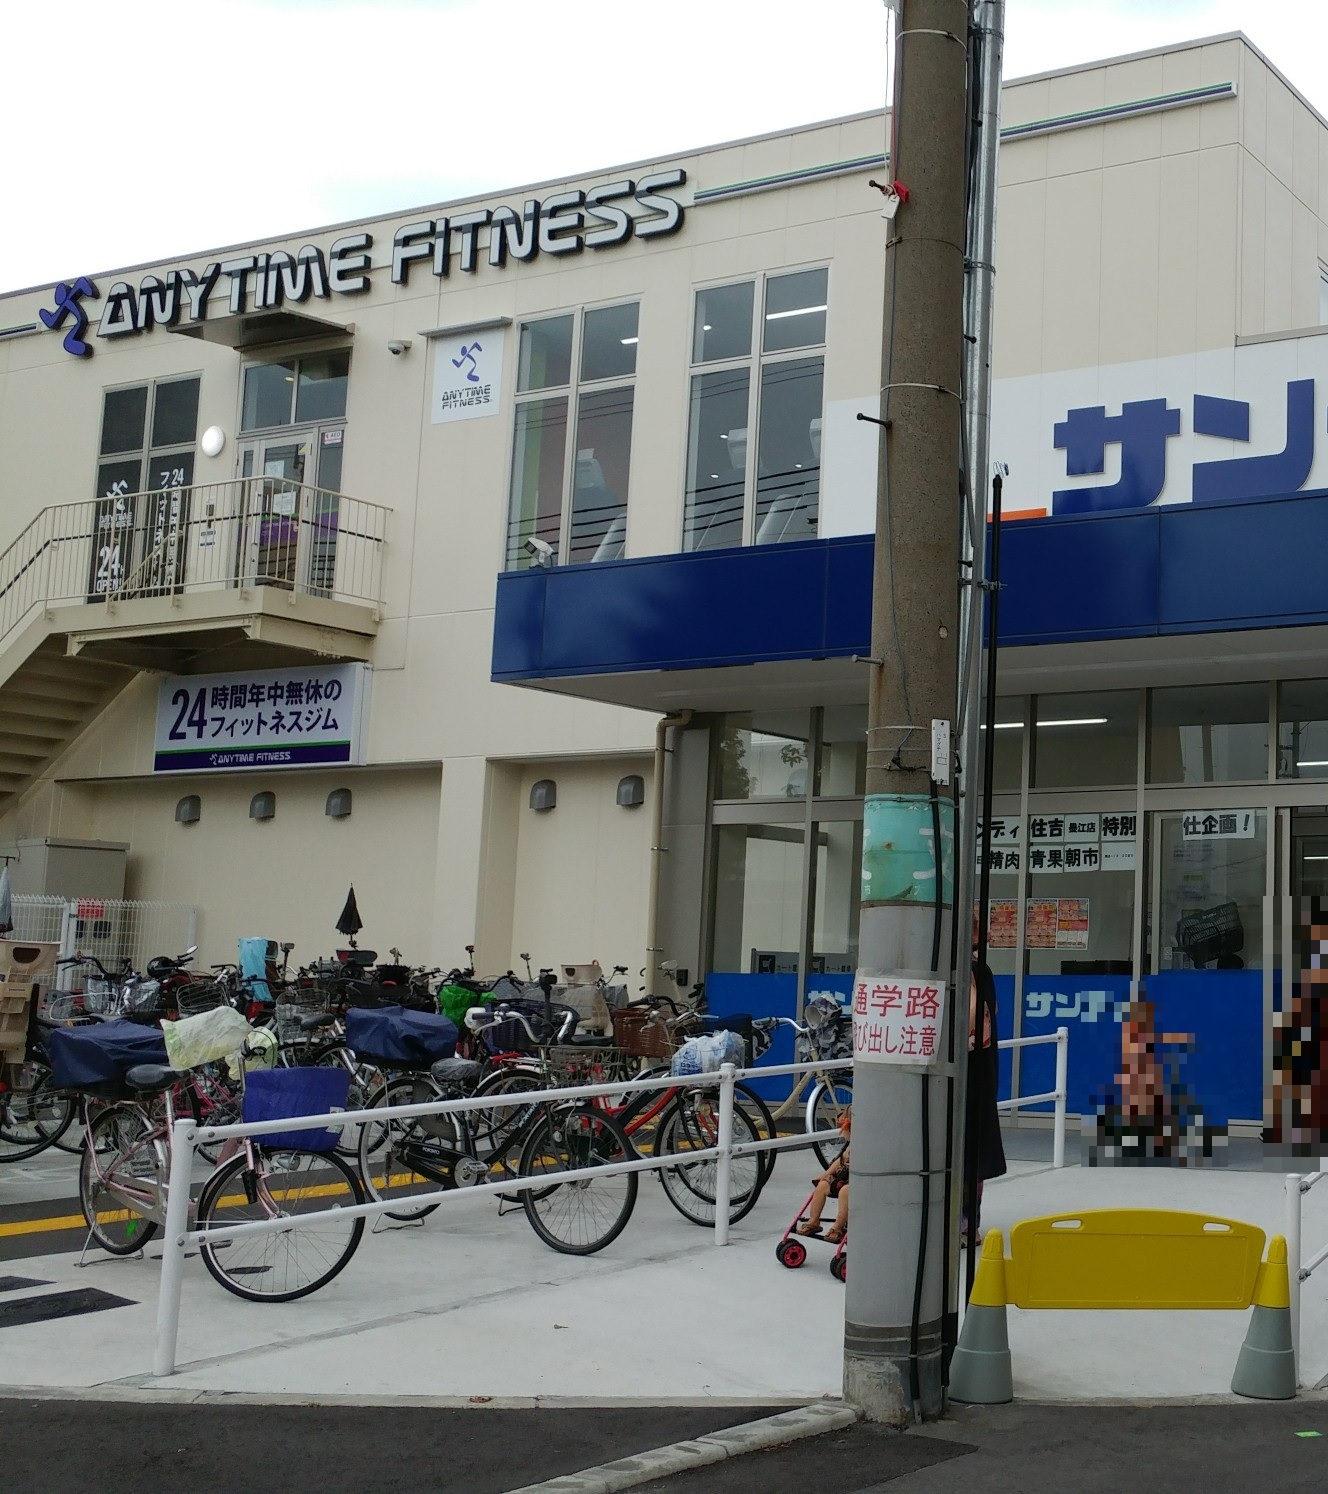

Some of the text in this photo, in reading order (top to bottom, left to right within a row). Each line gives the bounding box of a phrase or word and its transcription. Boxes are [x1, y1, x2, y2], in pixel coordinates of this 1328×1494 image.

[96, 169, 686, 338] ANYTIME FITNESS
[442, 384, 491, 401] ANYTIME
[442, 395, 491, 410] FITNESS
[211, 679, 342, 710] 時間年中無休の
[210, 707, 339, 738] フィットネスジム
[218, 751, 291, 763] ANYTIME FITNESS
[854, 983, 940, 1019] 通学路
